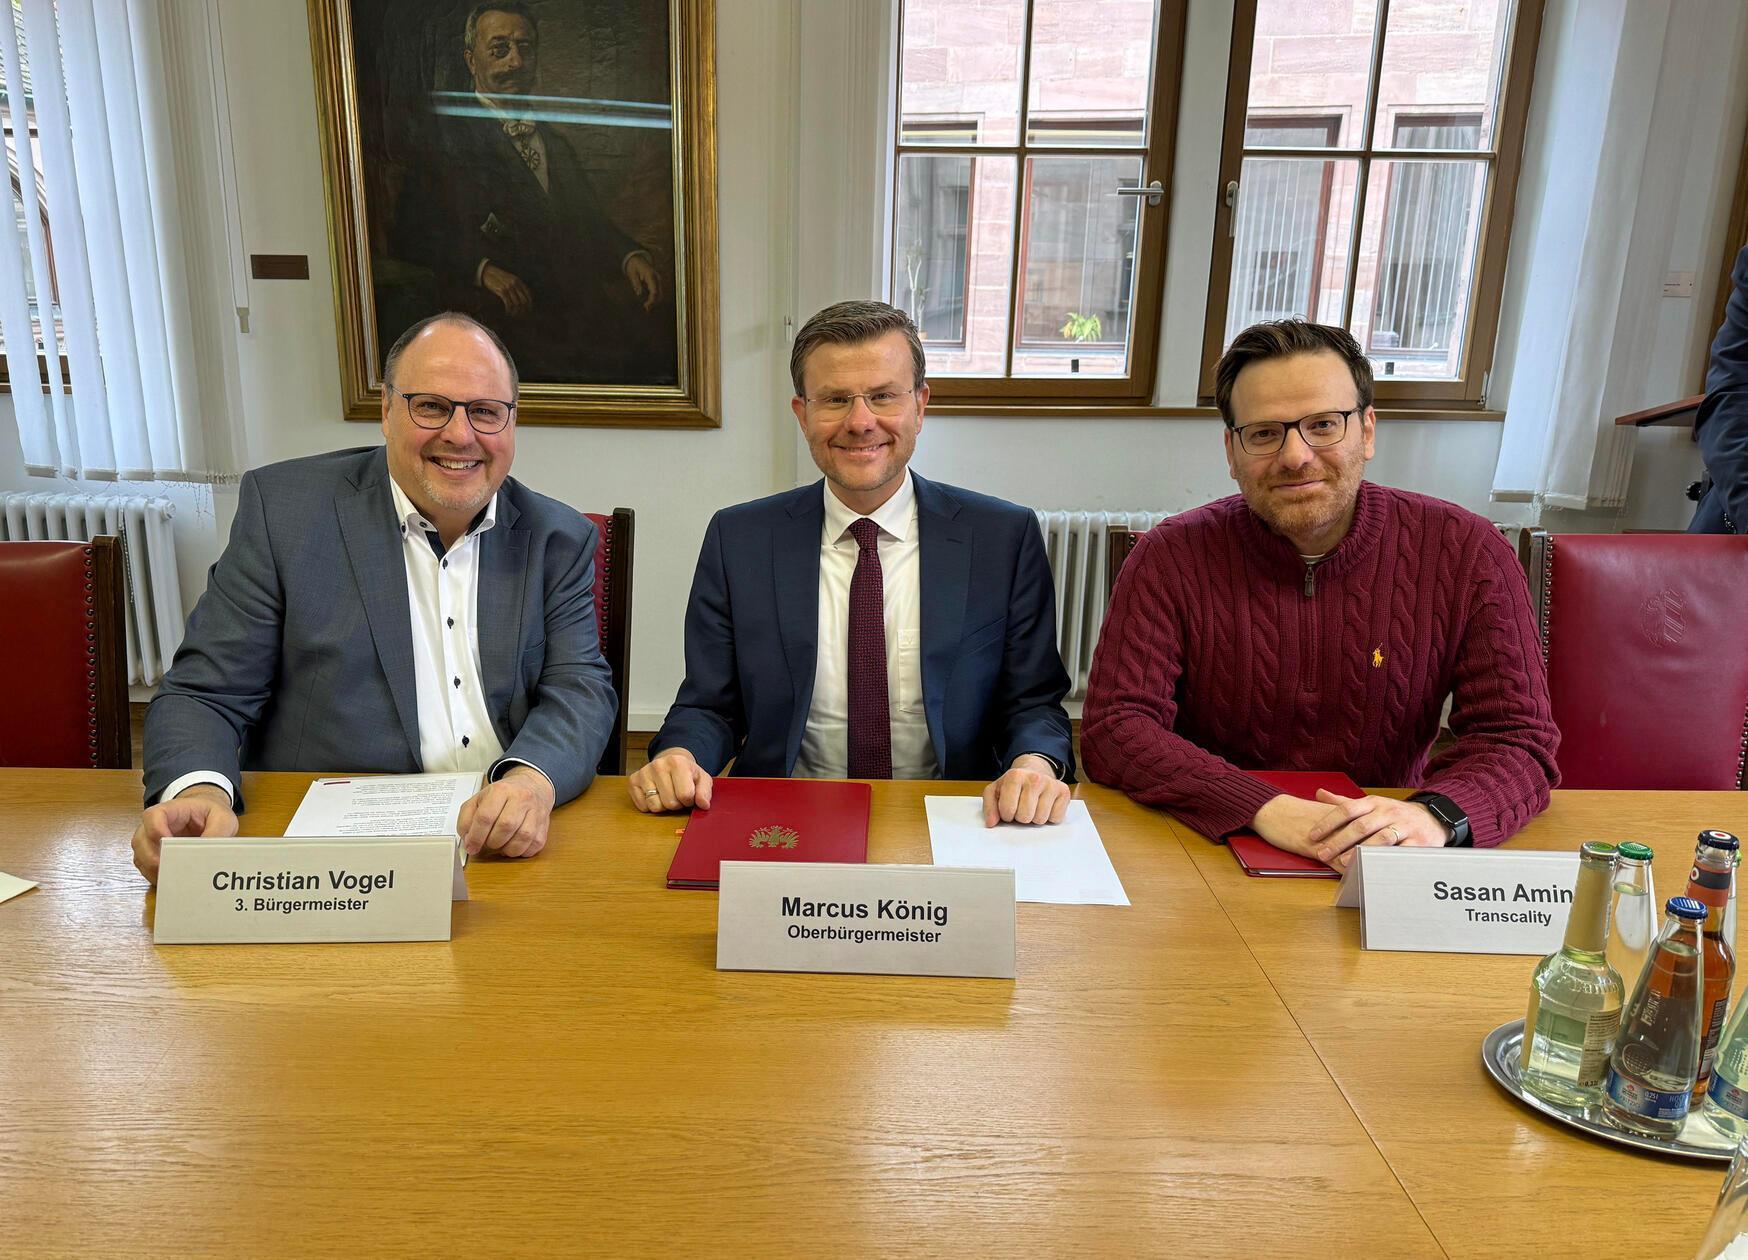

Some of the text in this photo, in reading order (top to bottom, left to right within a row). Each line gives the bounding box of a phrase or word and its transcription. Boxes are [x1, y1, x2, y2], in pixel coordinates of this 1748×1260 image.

[212, 870, 394, 894] Christian Vogel
[1433, 881, 1573, 904] Sasan Amin
[234, 898, 369, 914] 3. Bürgermeister
[781, 896, 948, 926] Marcus König
[1465, 908, 1552, 927] Transcality
[787, 925, 942, 943] Oberbürgermeister
